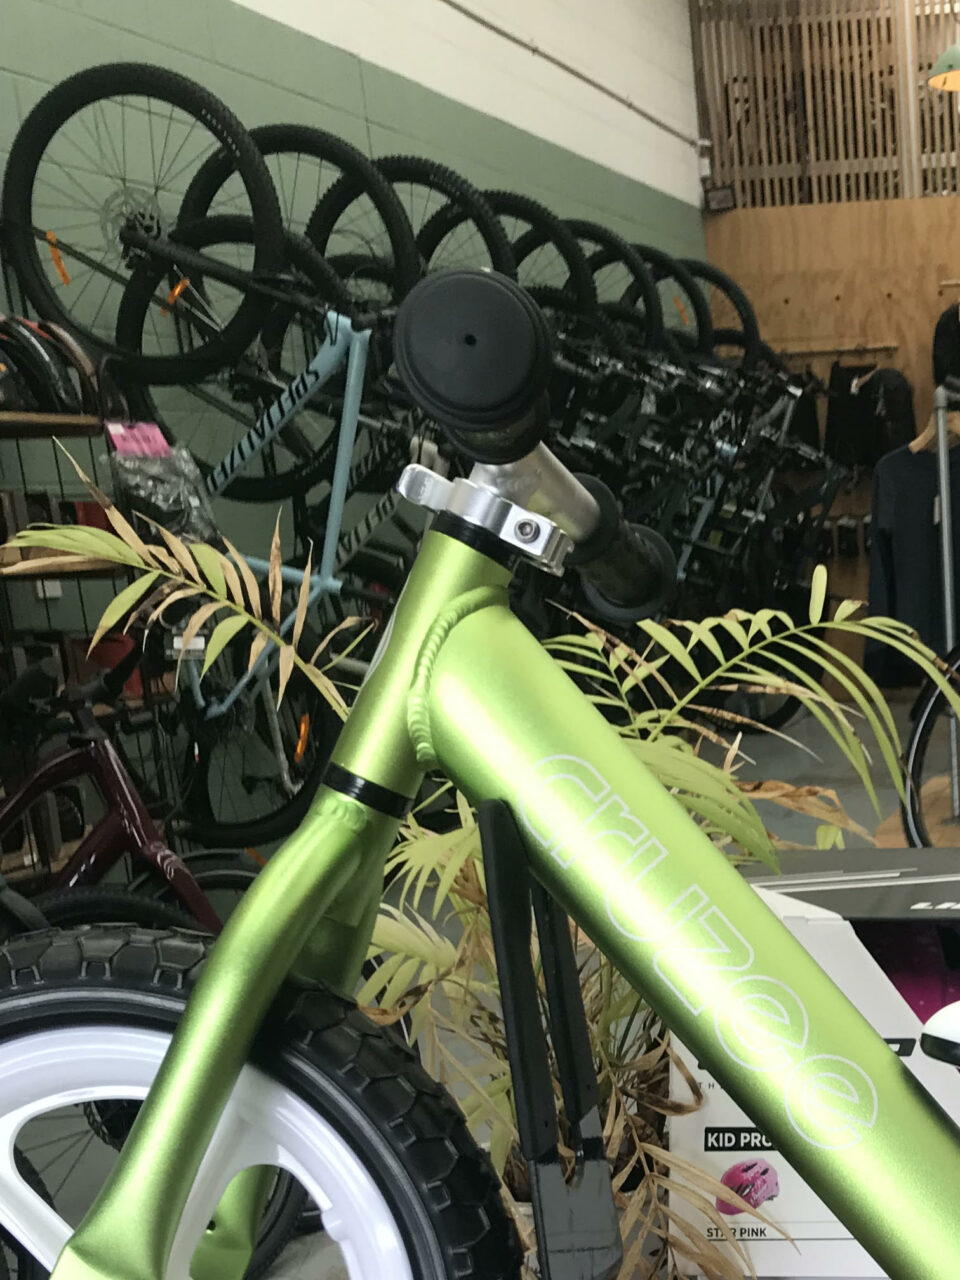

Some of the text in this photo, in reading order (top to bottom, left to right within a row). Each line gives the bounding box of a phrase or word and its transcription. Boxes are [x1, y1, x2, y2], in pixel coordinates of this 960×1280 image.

[206, 371, 319, 497] SPECIALIZED
[518, 753, 879, 1151] cruzee
[707, 1132, 772, 1148] KID PRO
[707, 1227, 767, 1238] STR PINK
